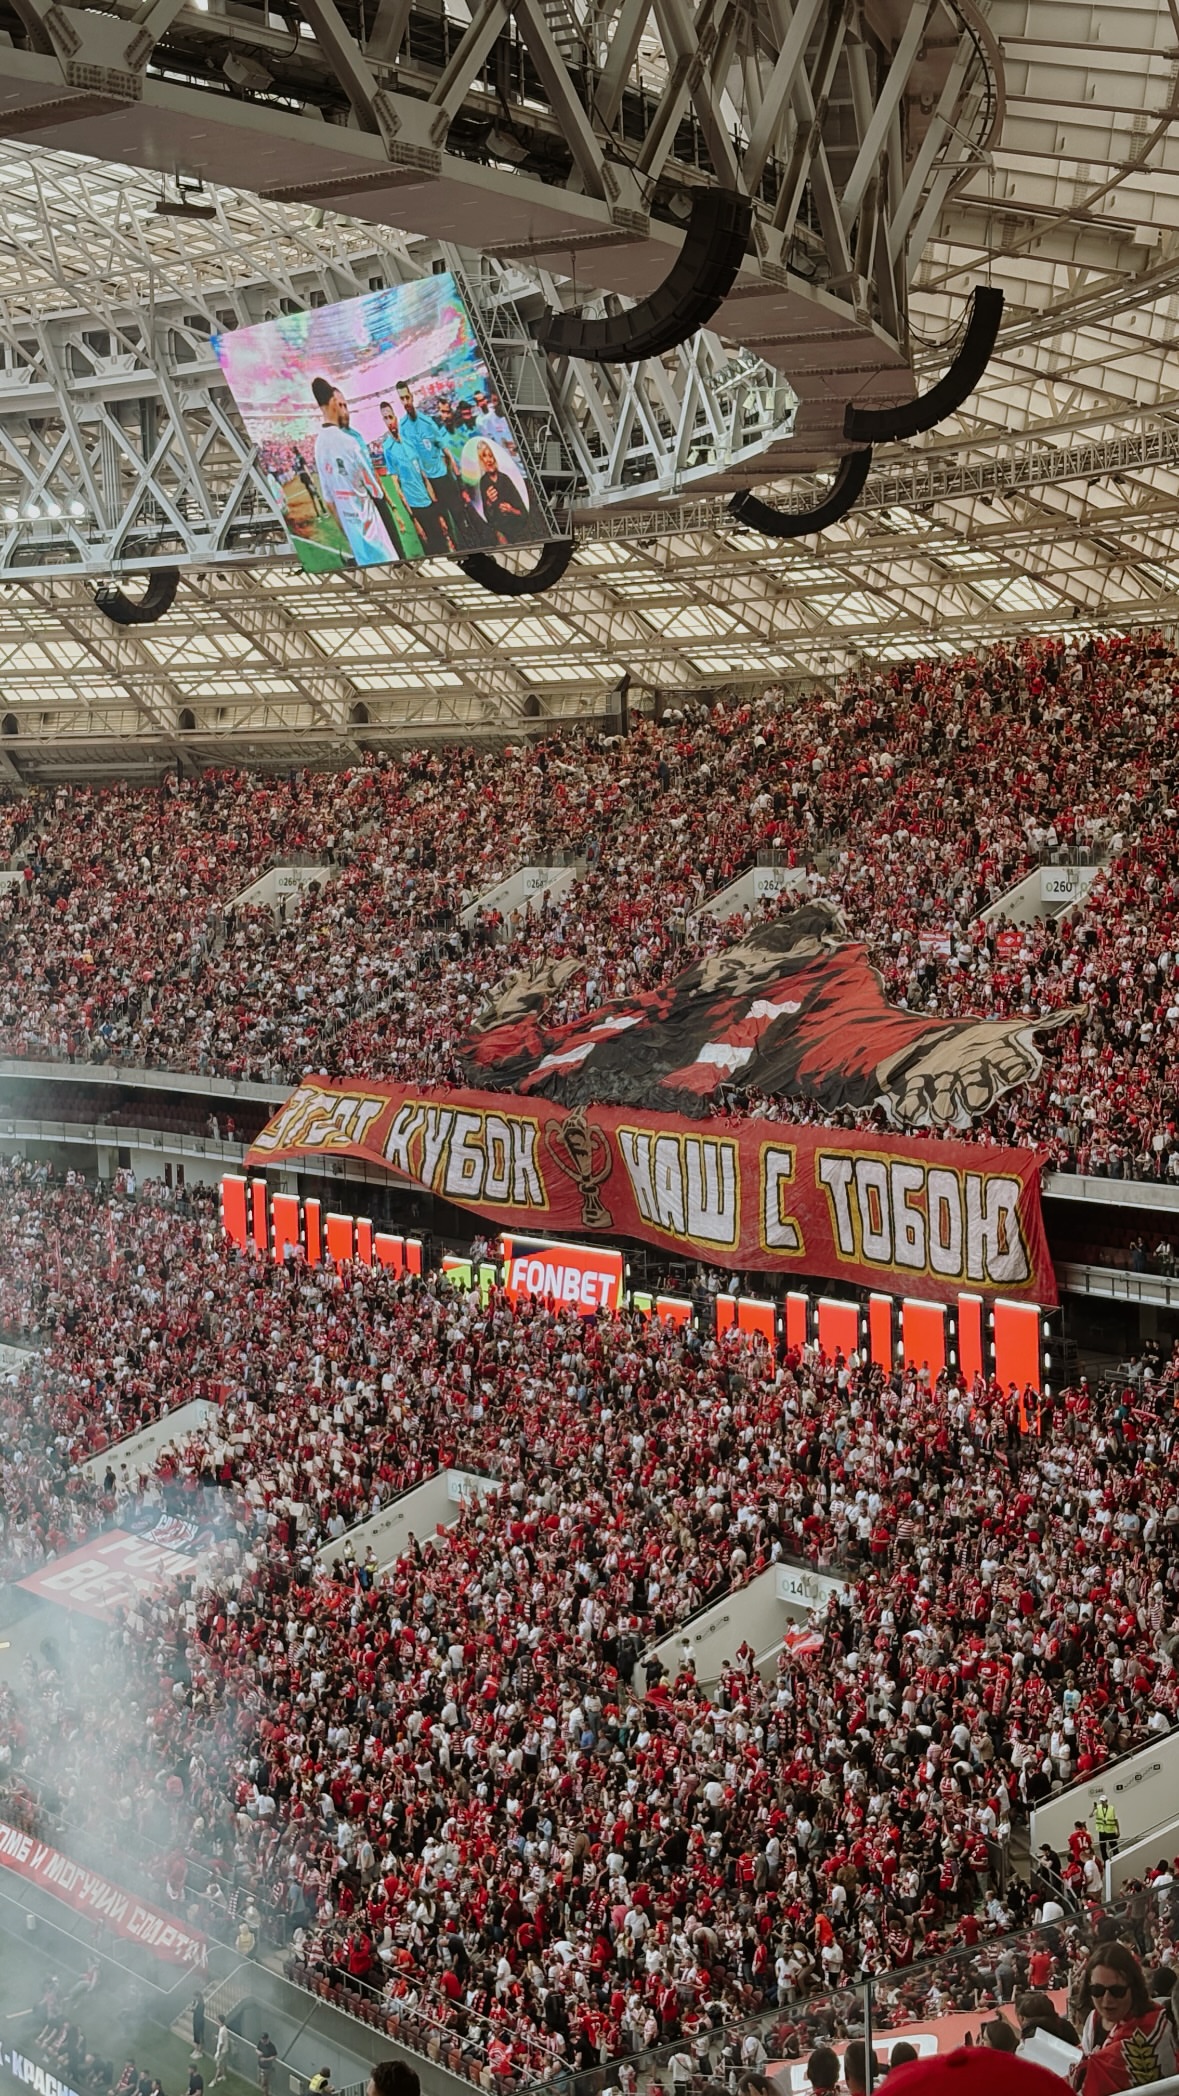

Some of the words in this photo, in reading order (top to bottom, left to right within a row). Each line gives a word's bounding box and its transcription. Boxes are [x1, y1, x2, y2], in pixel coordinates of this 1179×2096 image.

[384, 1101, 548, 1208] КУБОК
[617, 1127, 738, 1249] НАШ
[762, 1144, 803, 1253] С
[817, 1150, 1034, 1287] ТОБОЮ
[511, 1257, 616, 1305] FONBET
[43, 1852, 129, 1922] МОГУЧИЙ
